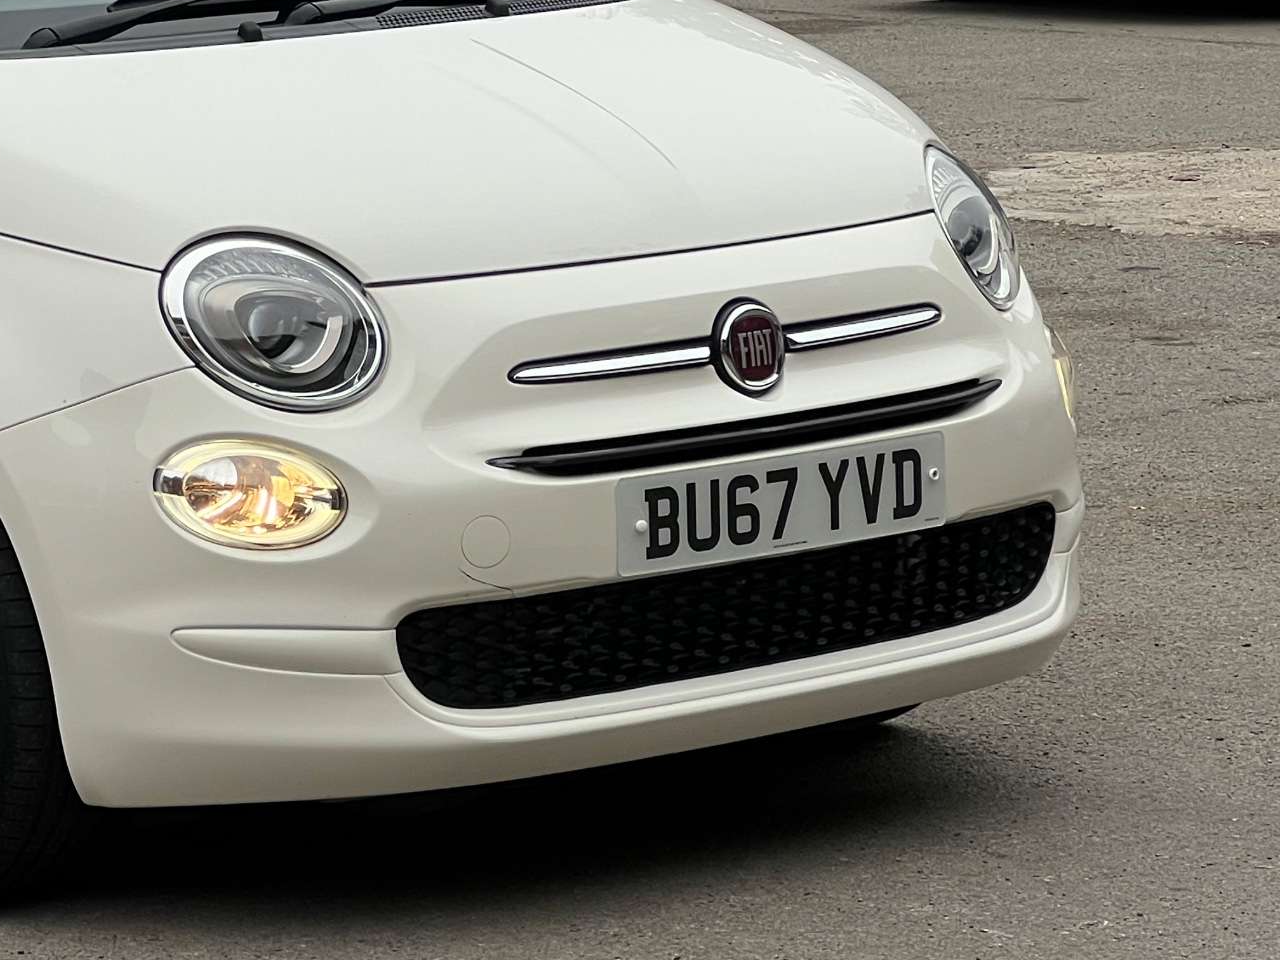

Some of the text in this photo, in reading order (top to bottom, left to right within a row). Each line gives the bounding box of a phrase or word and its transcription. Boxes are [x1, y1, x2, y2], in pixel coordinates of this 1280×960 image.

[737, 328, 773, 369] FIAT
[644, 448, 923, 560] BU67 YVD
